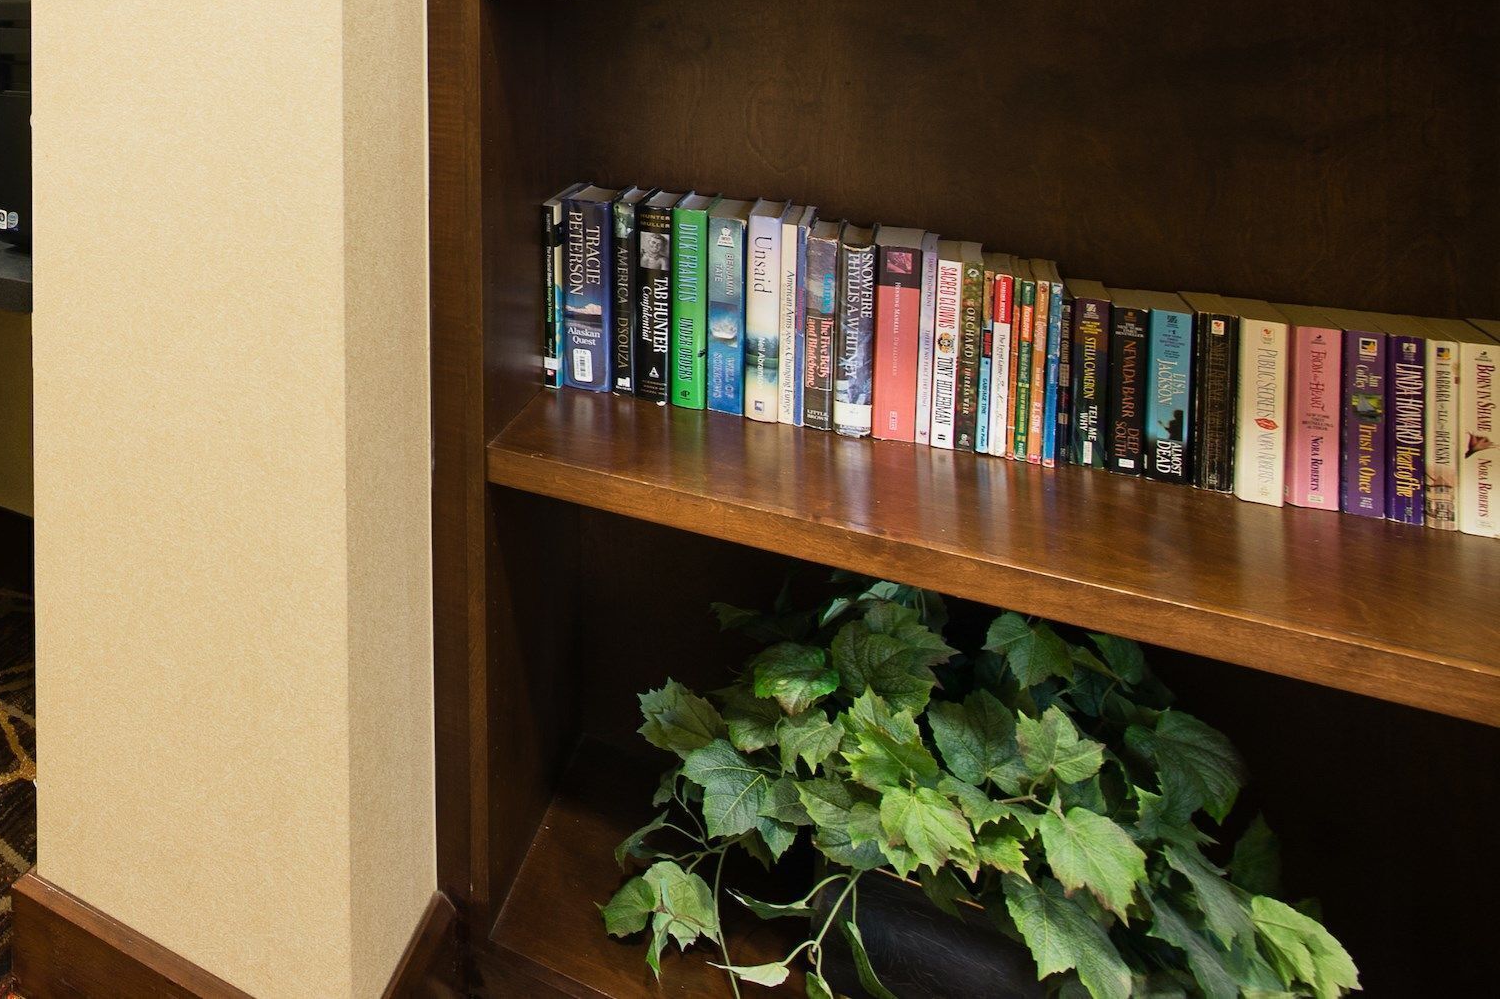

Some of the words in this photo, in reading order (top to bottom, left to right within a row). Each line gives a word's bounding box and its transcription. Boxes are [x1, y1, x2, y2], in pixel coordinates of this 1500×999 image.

[569, 211, 583, 295] PETERSON
[678, 223, 699, 252] DICK
[586, 226, 600, 284] TRACIE
[753, 236, 772, 293] Unsaid
[617, 246, 628, 304] AMERICA
[653, 277, 668, 299] TAB
[679, 254, 698, 302] FRANCIS
[861, 253, 873, 318] SNOWFIRE
[941, 267, 957, 295] SACRED
[641, 286, 652, 341] Confidential
[653, 302, 668, 353] HUNTER
[938, 298, 955, 329] CLOWNS
[568, 327, 600, 338] Alaskan
[573, 336, 596, 345] Quest
[618, 318, 628, 368] D'SOUZA
[679, 318, 693, 346] UNDER
[965, 308, 975, 358] ORCHARD
[678, 348, 692, 381] ORDERS
[1085, 337, 1095, 361] STELLA
[1123, 341, 1136, 384] NEVADA
[937, 357, 953, 376] TONY
[1083, 362, 1095, 400] CAMERON
[1157, 358, 1178, 404] JACKSON
[1395, 363, 1423, 395] LINDA
[1476, 364, 1495, 389] BORN
[1174, 373, 1186, 394] LISA
[935, 380, 952, 425] HILLERMAN
[1090, 405, 1098, 425] TELL
[1122, 387, 1135, 418] BARR
[1477, 403, 1496, 432] SHAME
[1079, 412, 1088, 431] WHY
[1089, 428, 1096, 441] ME
[1359, 423, 1375, 451] Trust
[1395, 398, 1423, 445] HOWARD
[1115, 421, 1126, 457] SOUTH
[1128, 428, 1139, 454] DEEP
[1311, 436, 1323, 457] NORA
[1156, 440, 1170, 473] DEAD
[1170, 442, 1181, 476] ALMOST
[1311, 457, 1323, 491] ROBERTS
[1359, 467, 1375, 494] Once
